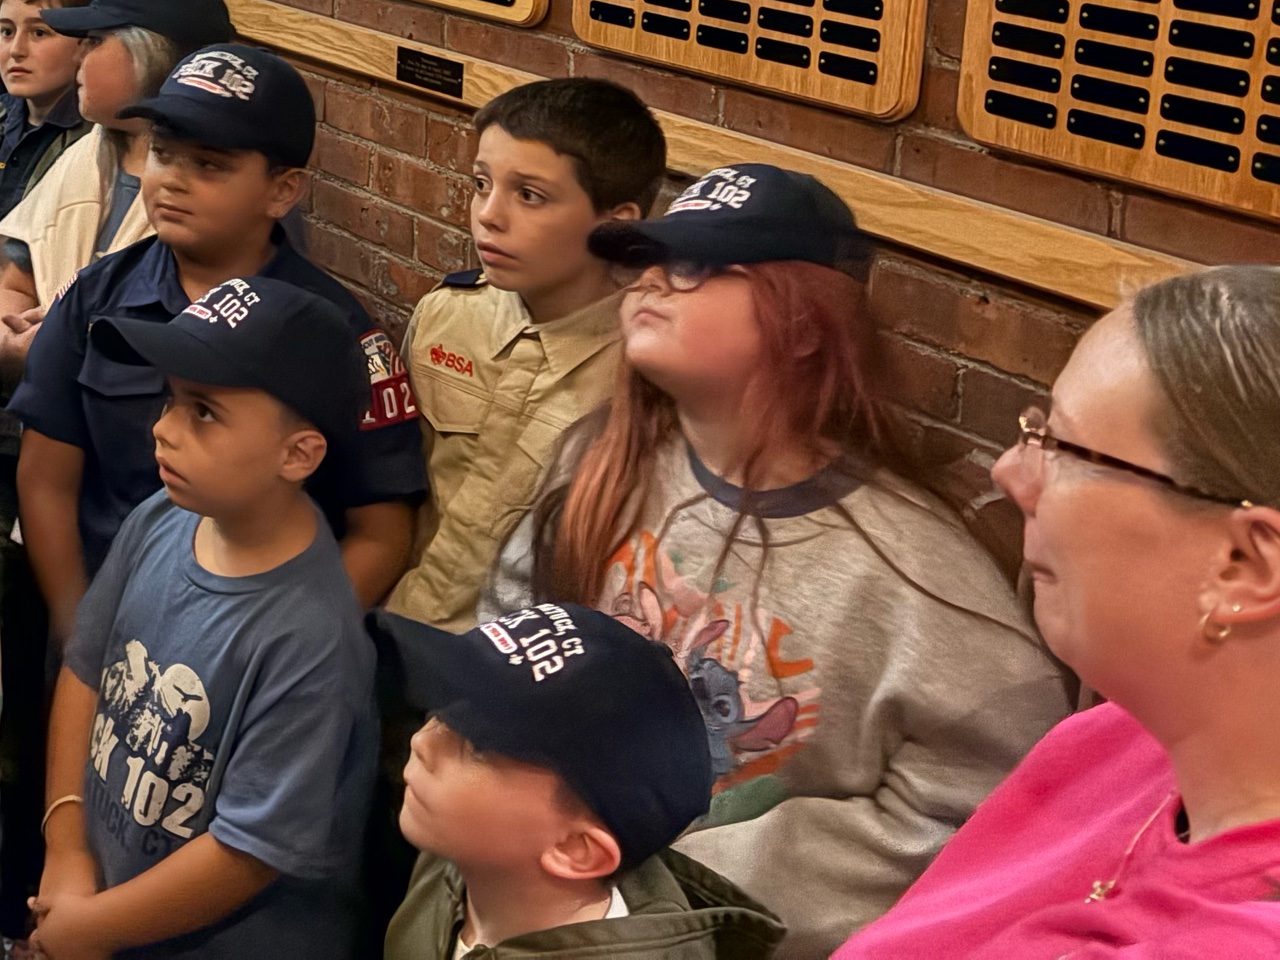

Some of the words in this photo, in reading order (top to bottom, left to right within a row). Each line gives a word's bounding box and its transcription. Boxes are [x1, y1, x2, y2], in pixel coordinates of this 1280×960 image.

[706, 181, 751, 209] 102
[213, 293, 249, 329] 102
[244, 292, 261, 307] CT
[445, 353, 474, 377] BSA
[519, 628, 565, 682] 102
[561, 637, 585, 658] CT
[121, 756, 205, 839] 102
